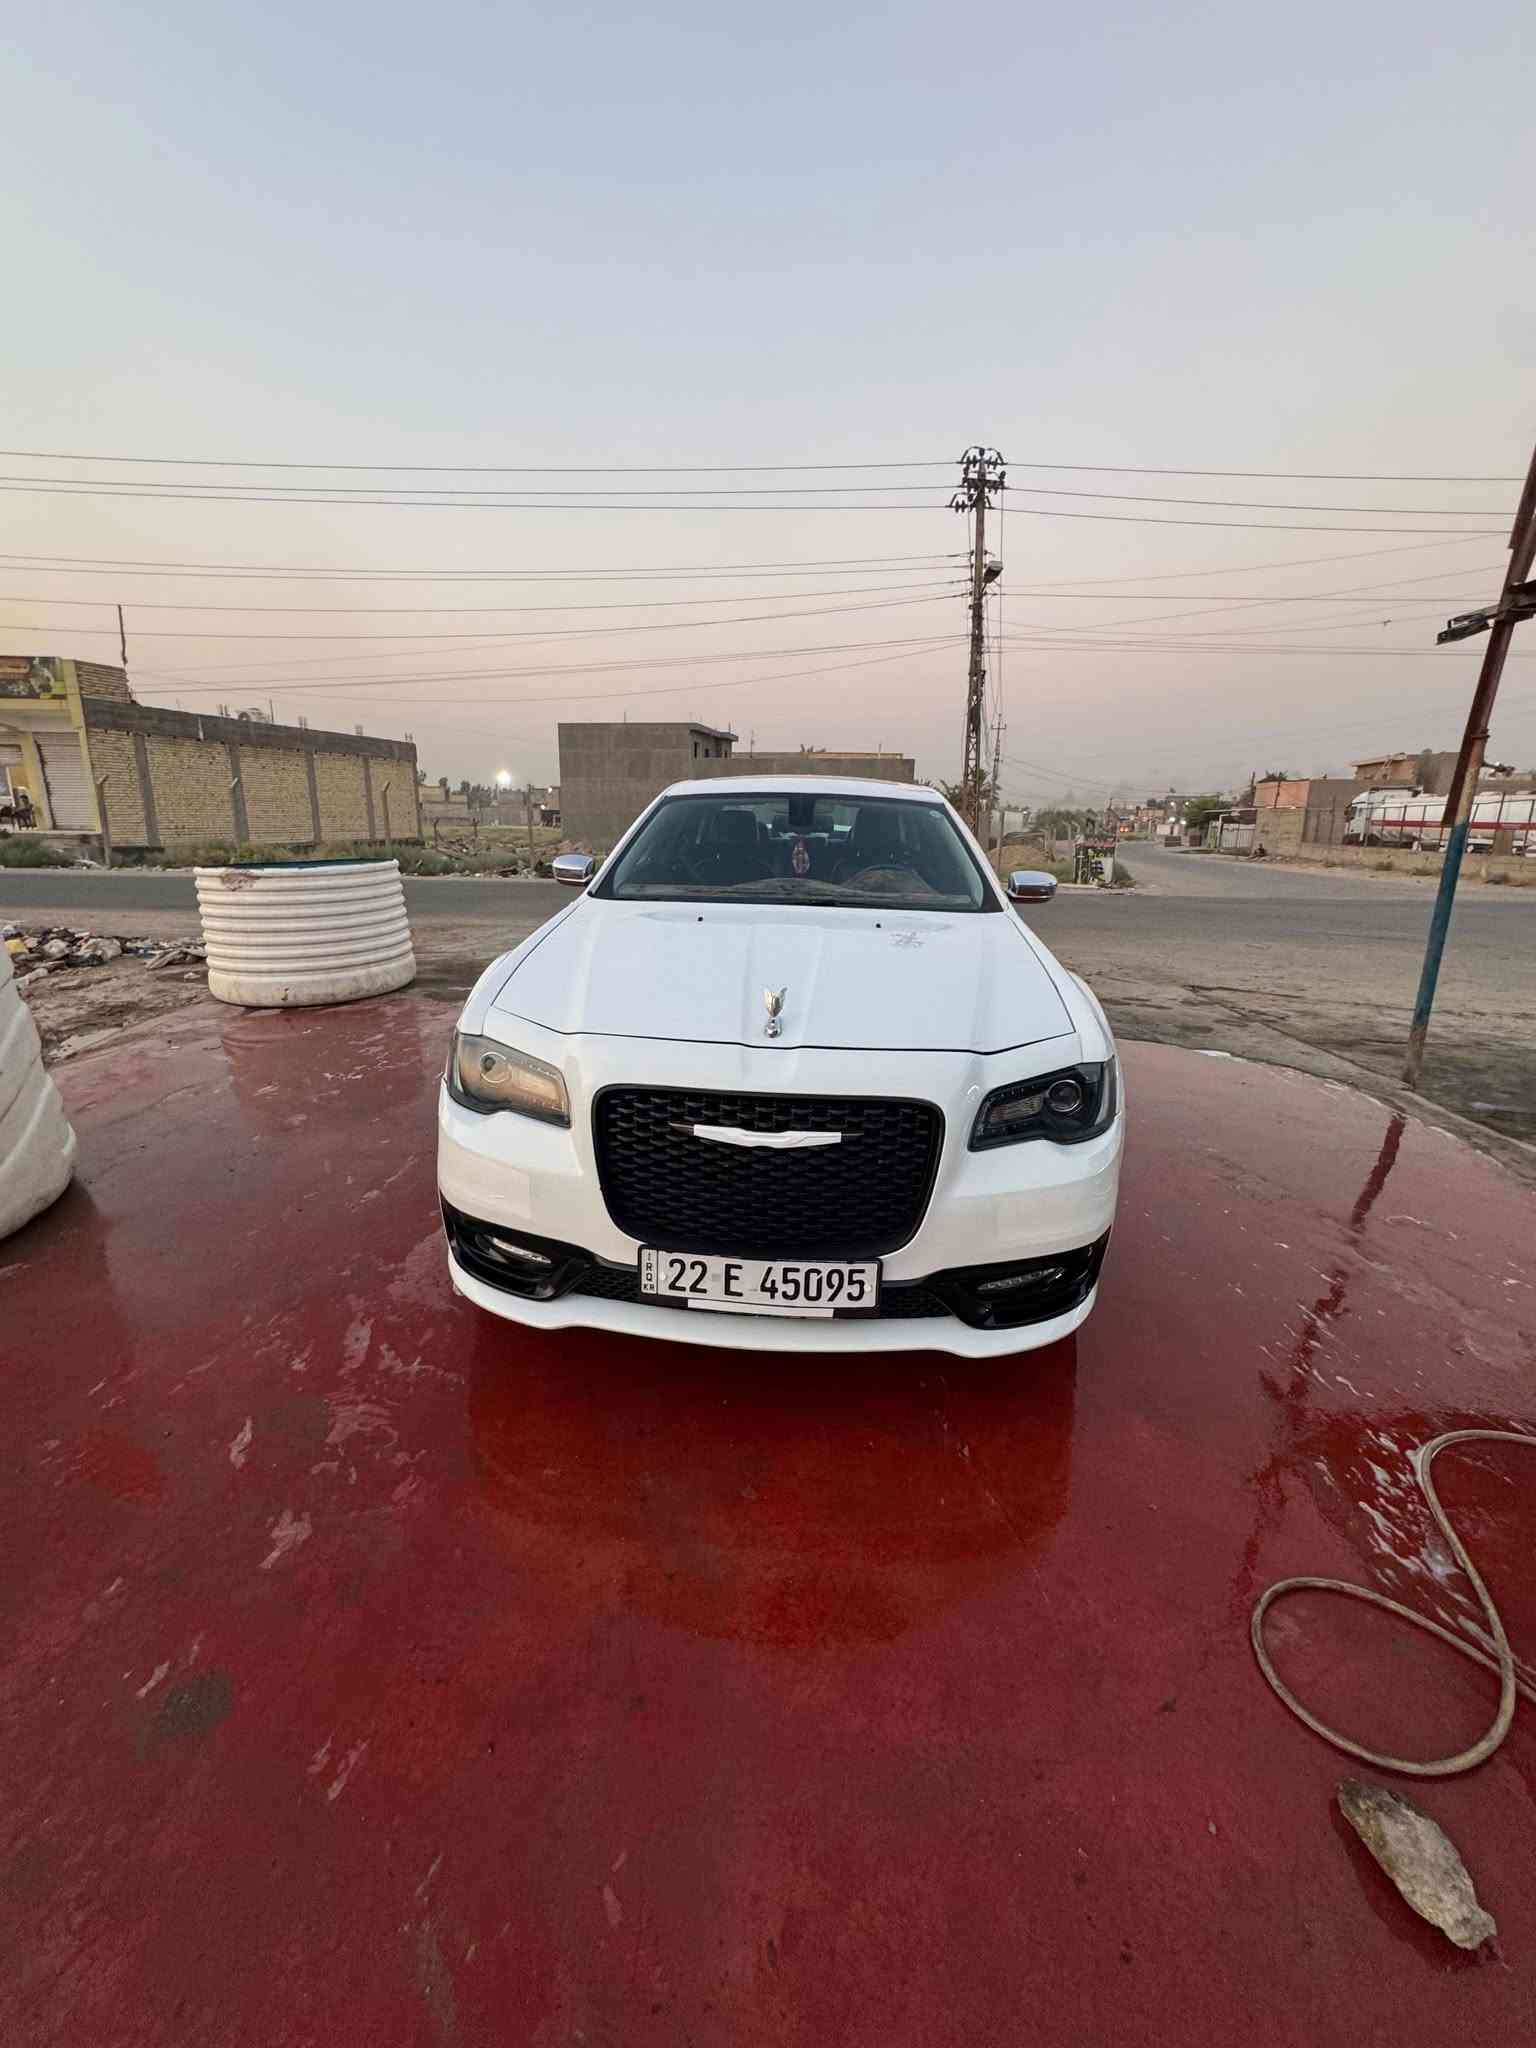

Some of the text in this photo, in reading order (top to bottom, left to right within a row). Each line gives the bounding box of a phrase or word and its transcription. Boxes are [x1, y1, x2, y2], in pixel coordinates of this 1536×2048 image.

[668, 1258, 866, 1302] 22 E 45095
